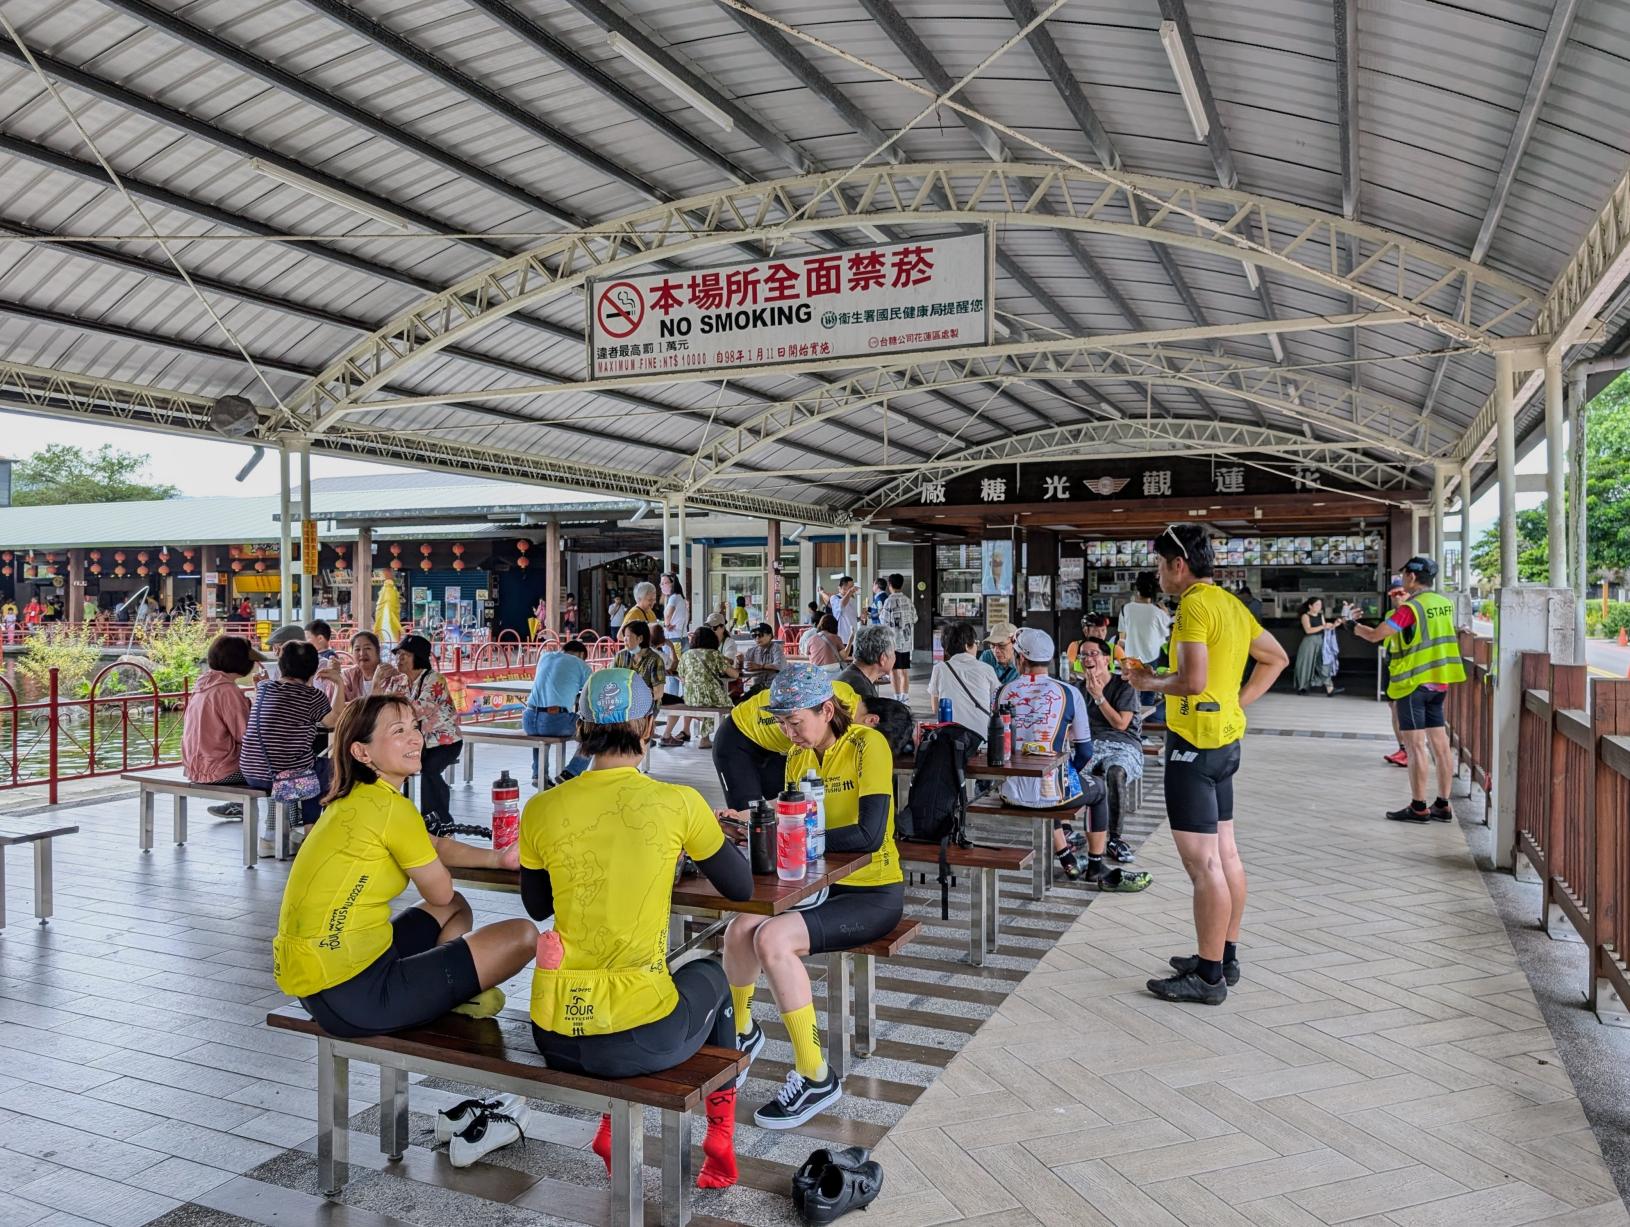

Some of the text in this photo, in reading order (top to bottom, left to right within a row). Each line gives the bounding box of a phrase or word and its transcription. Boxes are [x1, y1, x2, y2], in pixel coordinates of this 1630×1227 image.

[649, 246, 934, 316] 本場所全面禁菸
[660, 303, 812, 338] NO SMOKING
[598, 359, 635, 373] MAXIMUM
[682, 354, 707, 367] 10000
[1426, 606, 1452, 619] STAFF
[565, 1005, 594, 1016] TOUR
